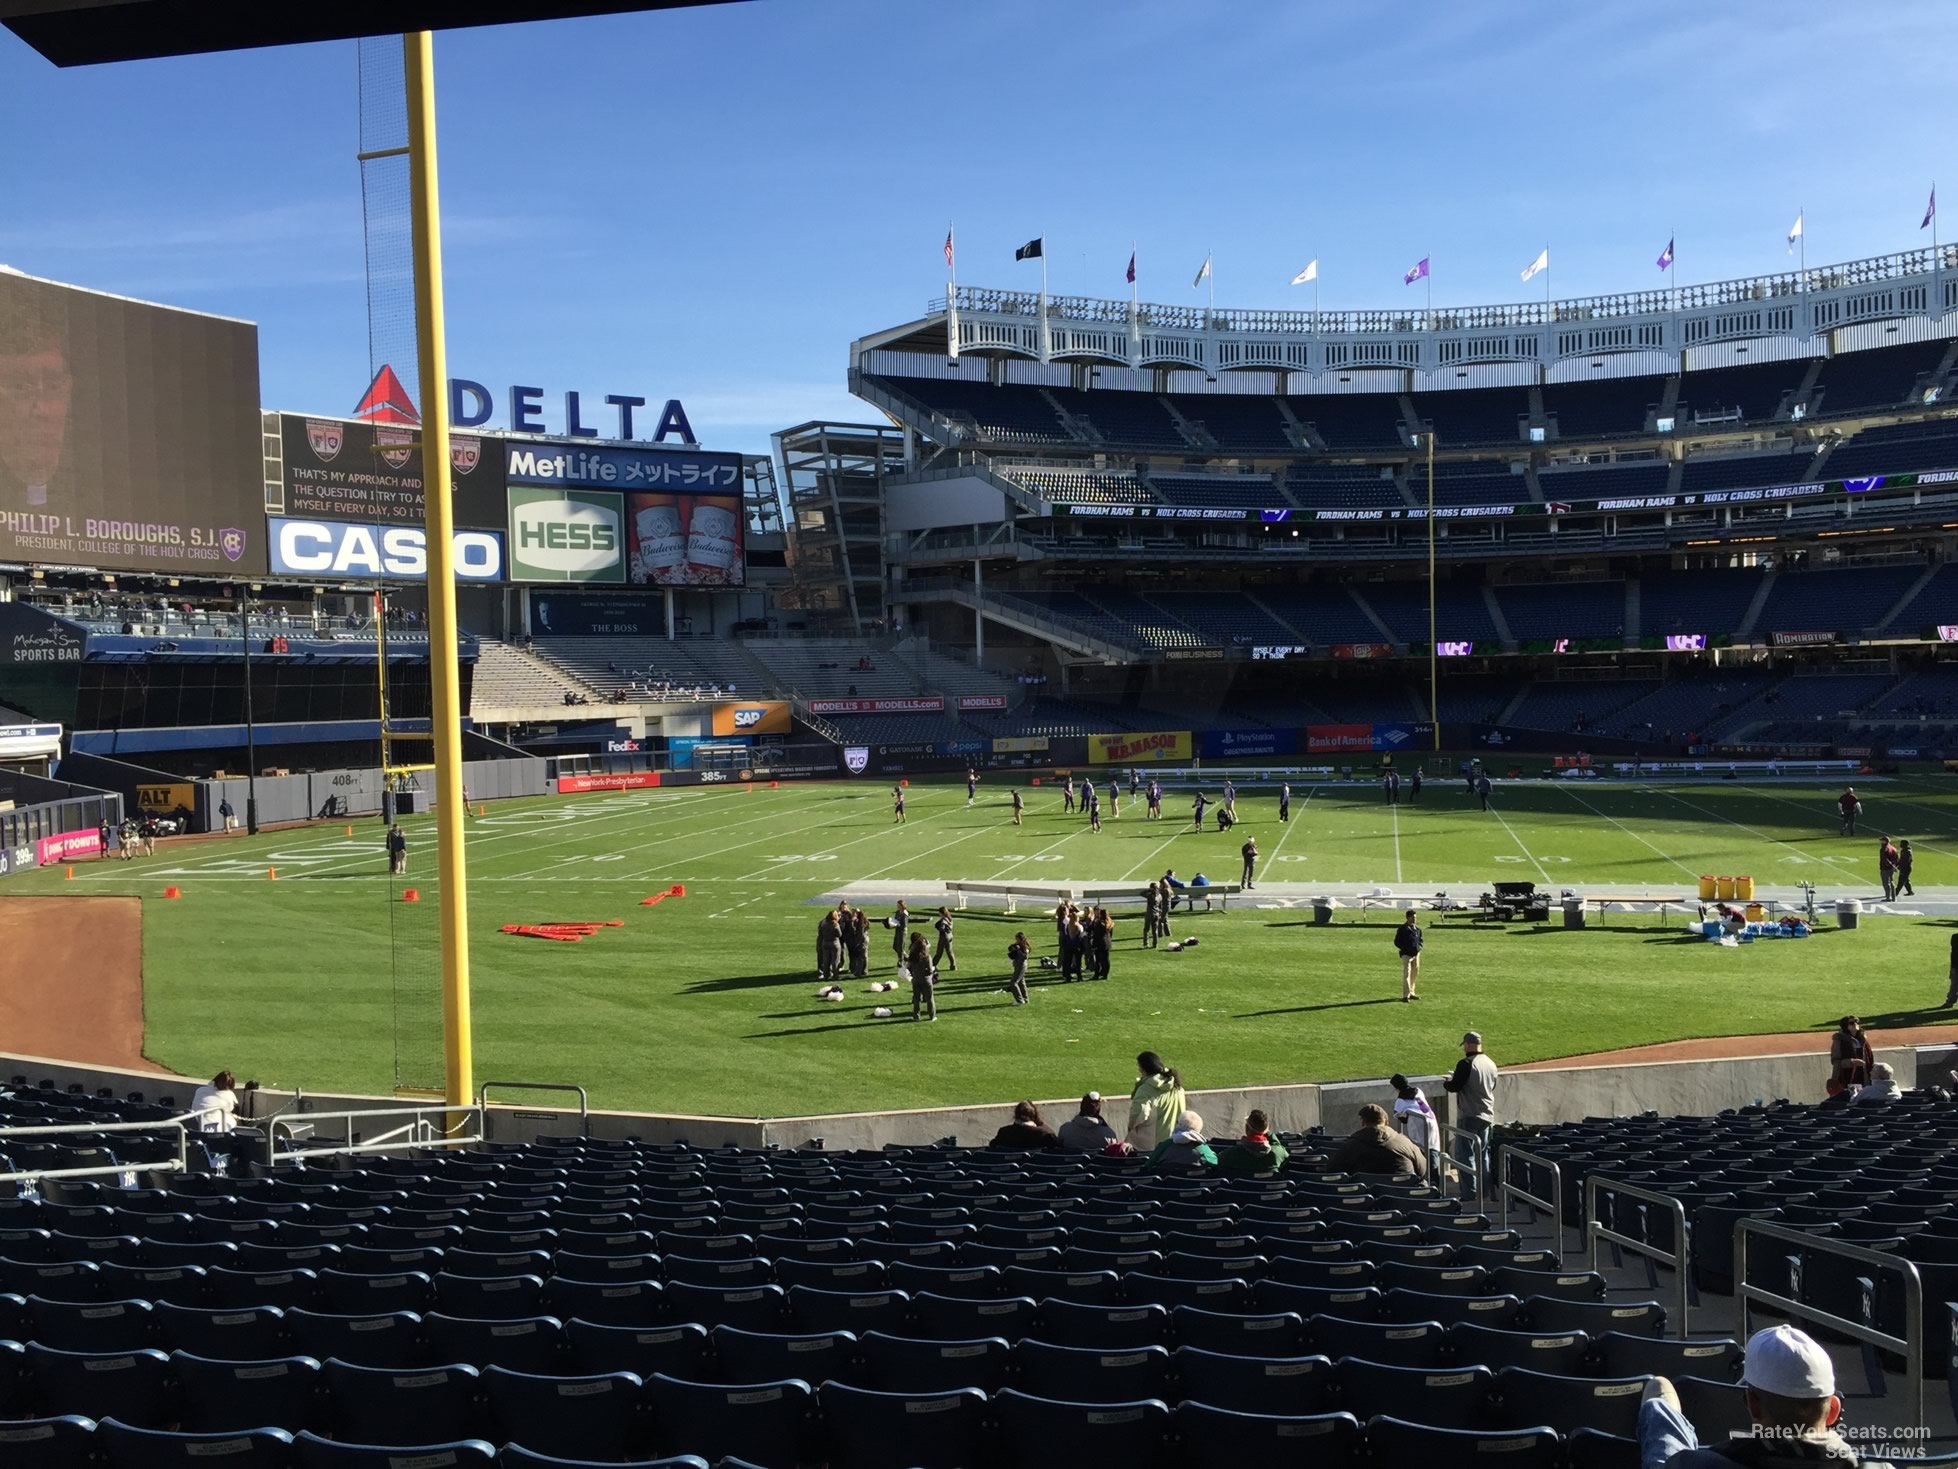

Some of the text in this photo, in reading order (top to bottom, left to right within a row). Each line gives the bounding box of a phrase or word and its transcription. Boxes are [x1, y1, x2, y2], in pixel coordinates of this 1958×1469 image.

[450, 378, 697, 443] DELTA
[509, 451, 617, 481] MetLife
[626, 461, 737, 485] メットライフ
[293, 468, 421, 488] THAT'S MY APPROACH AND
[294, 484, 313, 495] THE
[316, 486, 367, 499] QUESTION
[376, 491, 396, 501] TRY
[399, 493, 413, 503] TO
[1597, 498, 1644, 510] FORDHAM
[1646, 496, 1675, 507] RAMS
[1703, 492, 1728, 503] HOLY
[1730, 489, 1763, 501] CROSS
[1764, 483, 1825, 498] CRUSADERS
[294, 499, 332, 511] MYSELF
[334, 502, 365, 514] EVERY
[368, 505, 390, 517] DAY,
[393, 506, 406, 517] SO
[1070, 506, 1109, 516] FORDHAM
[1110, 507, 1134, 516] RAMS
[1156, 508, 1176, 517] HOLY
[1177, 508, 1201, 518] CROSS
[1203, 509, 1247, 519] CRUSADERS
[1316, 511, 1355, 520] FORDHAM
[1356, 510, 1383, 520] RAMS
[1407, 509, 1429, 518] HOLY
[1431, 507, 1458, 517] CROSS
[1460, 506, 1515, 516] CRUSADERS
[0, 510, 219, 547] PHILIP L. BOROUGHS, S.J.
[520, 521, 614, 550] HESS
[15, 535, 220, 560] PRESIDENT, COLLEGE OF THE HOLY CROSS
[280, 522, 499, 577] CASO
[591, 624, 638, 632] THE BOSS
[13, 634, 80, 647] Mohegan Sun
[1775, 631, 1835, 644] ADMIRATION
[14, 648, 80, 661] SPORTS BAR
[1182, 650, 1223, 658] BUSINESS
[814, 702, 857, 711] MODELL'S
[876, 700, 940, 710] MODELLS.com
[963, 698, 1001, 706] MODELL'S
[735, 711, 761, 728] SAP
[1236, 733, 1275, 743] PlayStation
[1309, 734, 1381, 746] Bank of America
[608, 740, 640, 752] FedEx
[958, 741, 982, 751] pepsi
[69, 834, 99, 849] DONUTS
